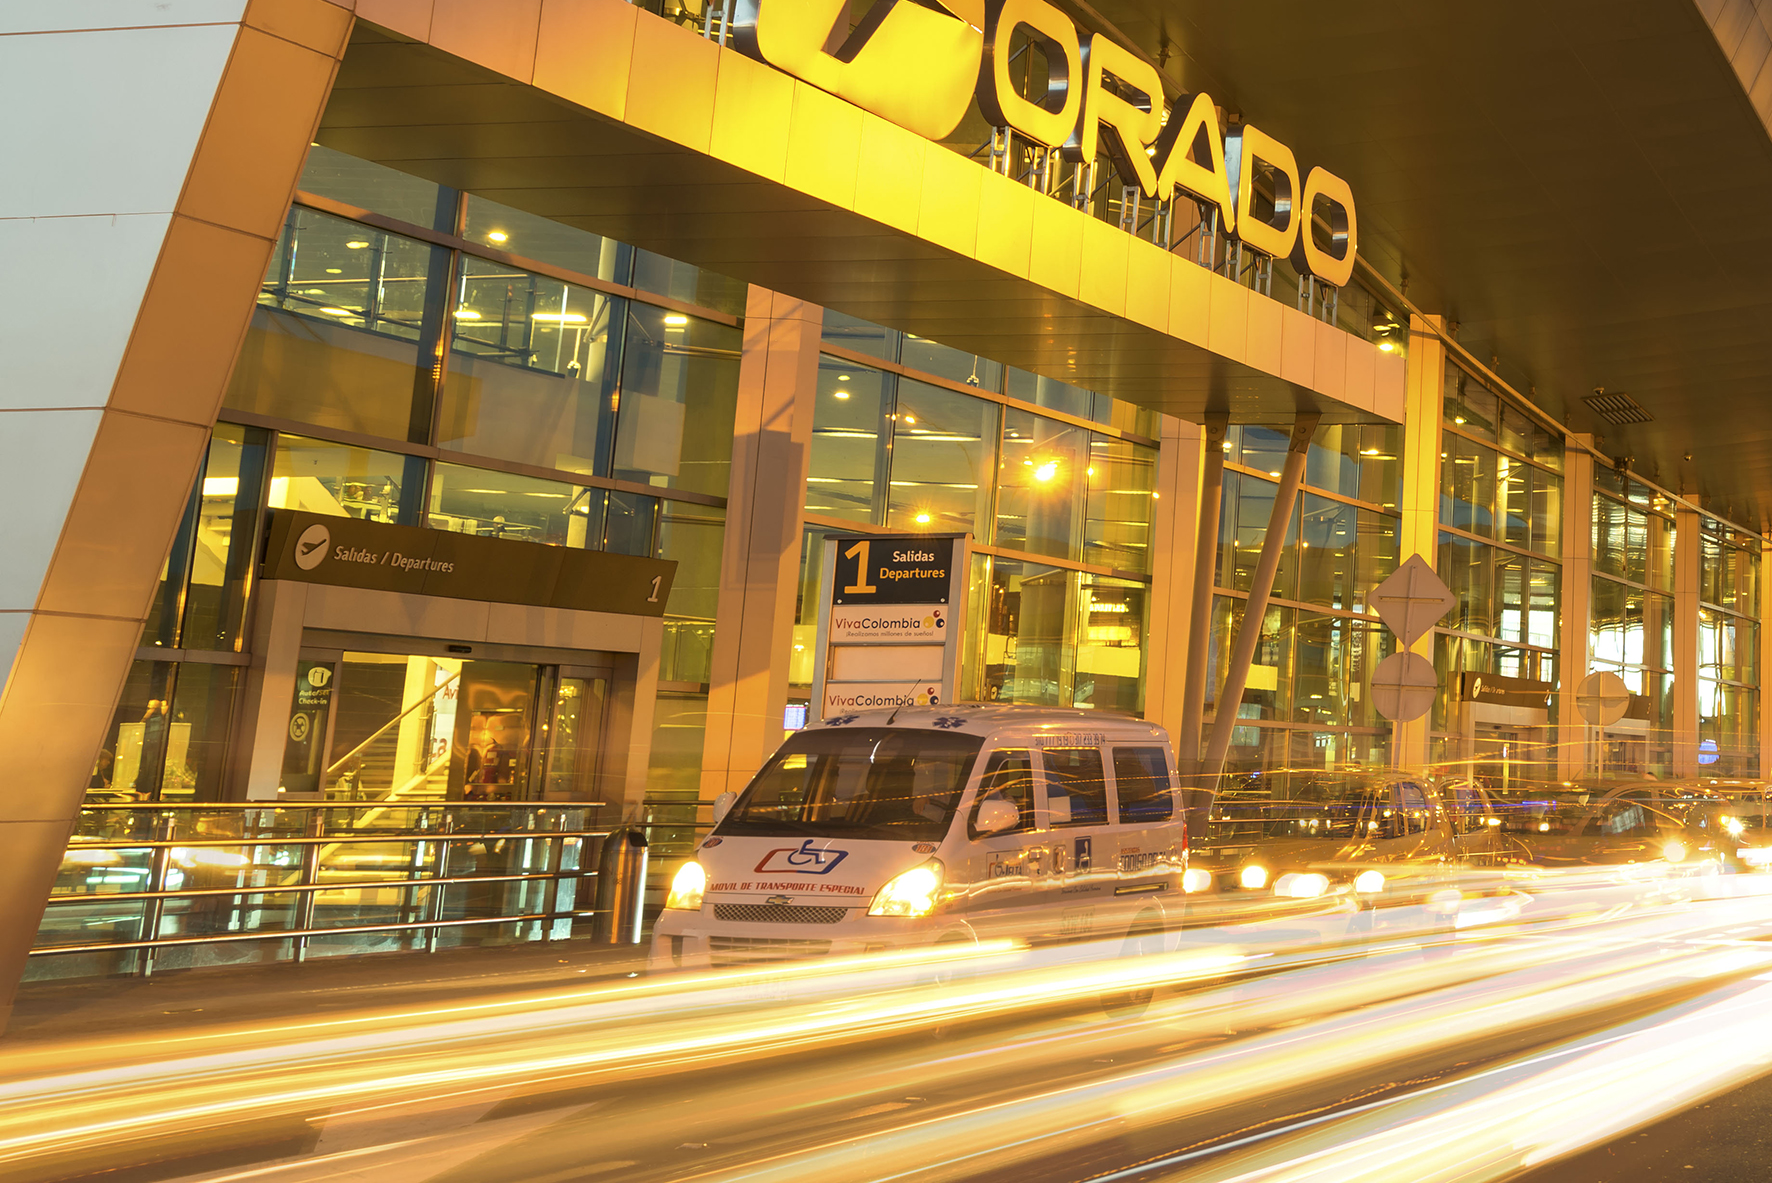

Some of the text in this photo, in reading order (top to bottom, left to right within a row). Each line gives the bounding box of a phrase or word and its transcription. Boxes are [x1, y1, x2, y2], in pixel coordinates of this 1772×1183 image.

[334, 545, 378, 565] Salidas
[390, 552, 455, 573] Departures
[892, 550, 935, 563] Salidas
[844, 540, 877, 594] 1
[879, 567, 945, 582] Departures
[646, 575, 662, 603] 1
[835, 618, 920, 629] VivaColombia
[829, 695, 914, 706] VivaColombia
[709, 882, 738, 891] MOVIL
[740, 882, 753, 890] DE
[755, 882, 817, 892] TRANSPORTE
